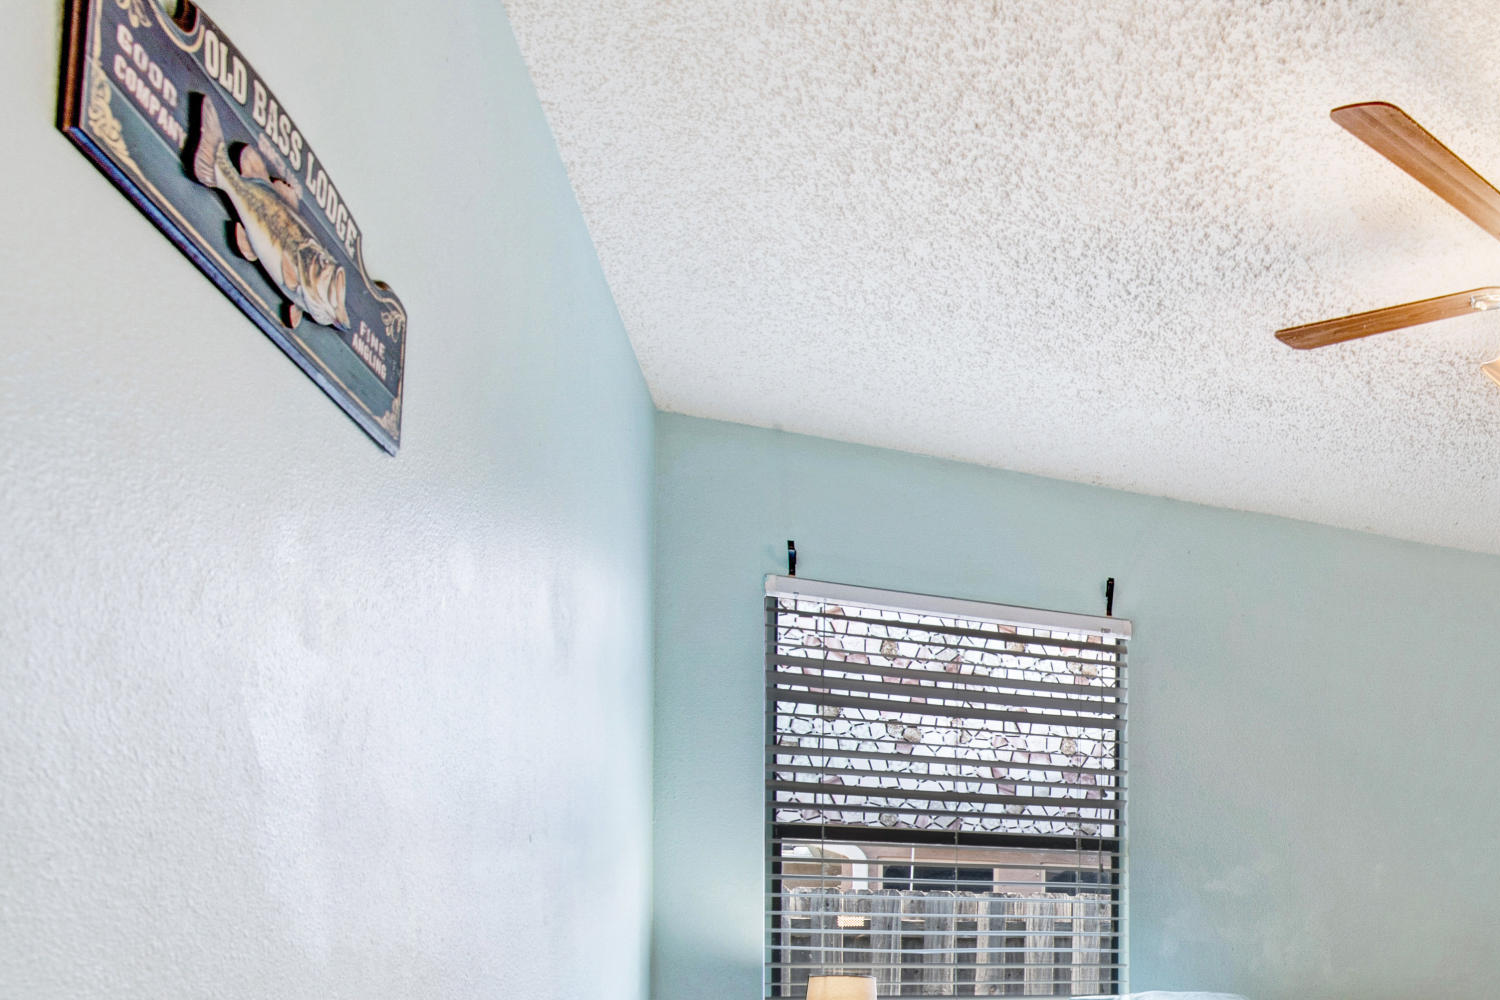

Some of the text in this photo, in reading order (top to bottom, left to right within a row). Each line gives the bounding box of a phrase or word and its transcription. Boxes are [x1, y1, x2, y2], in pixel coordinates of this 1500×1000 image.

[113, 53, 188, 151] COMPANY
[116, 23, 178, 108] GOOD
[203, 29, 248, 106] OLD
[252, 79, 302, 171] BASS
[305, 151, 358, 259] LODGE
[351, 332, 387, 381] ANGLING
[359, 320, 386, 361] FINE
